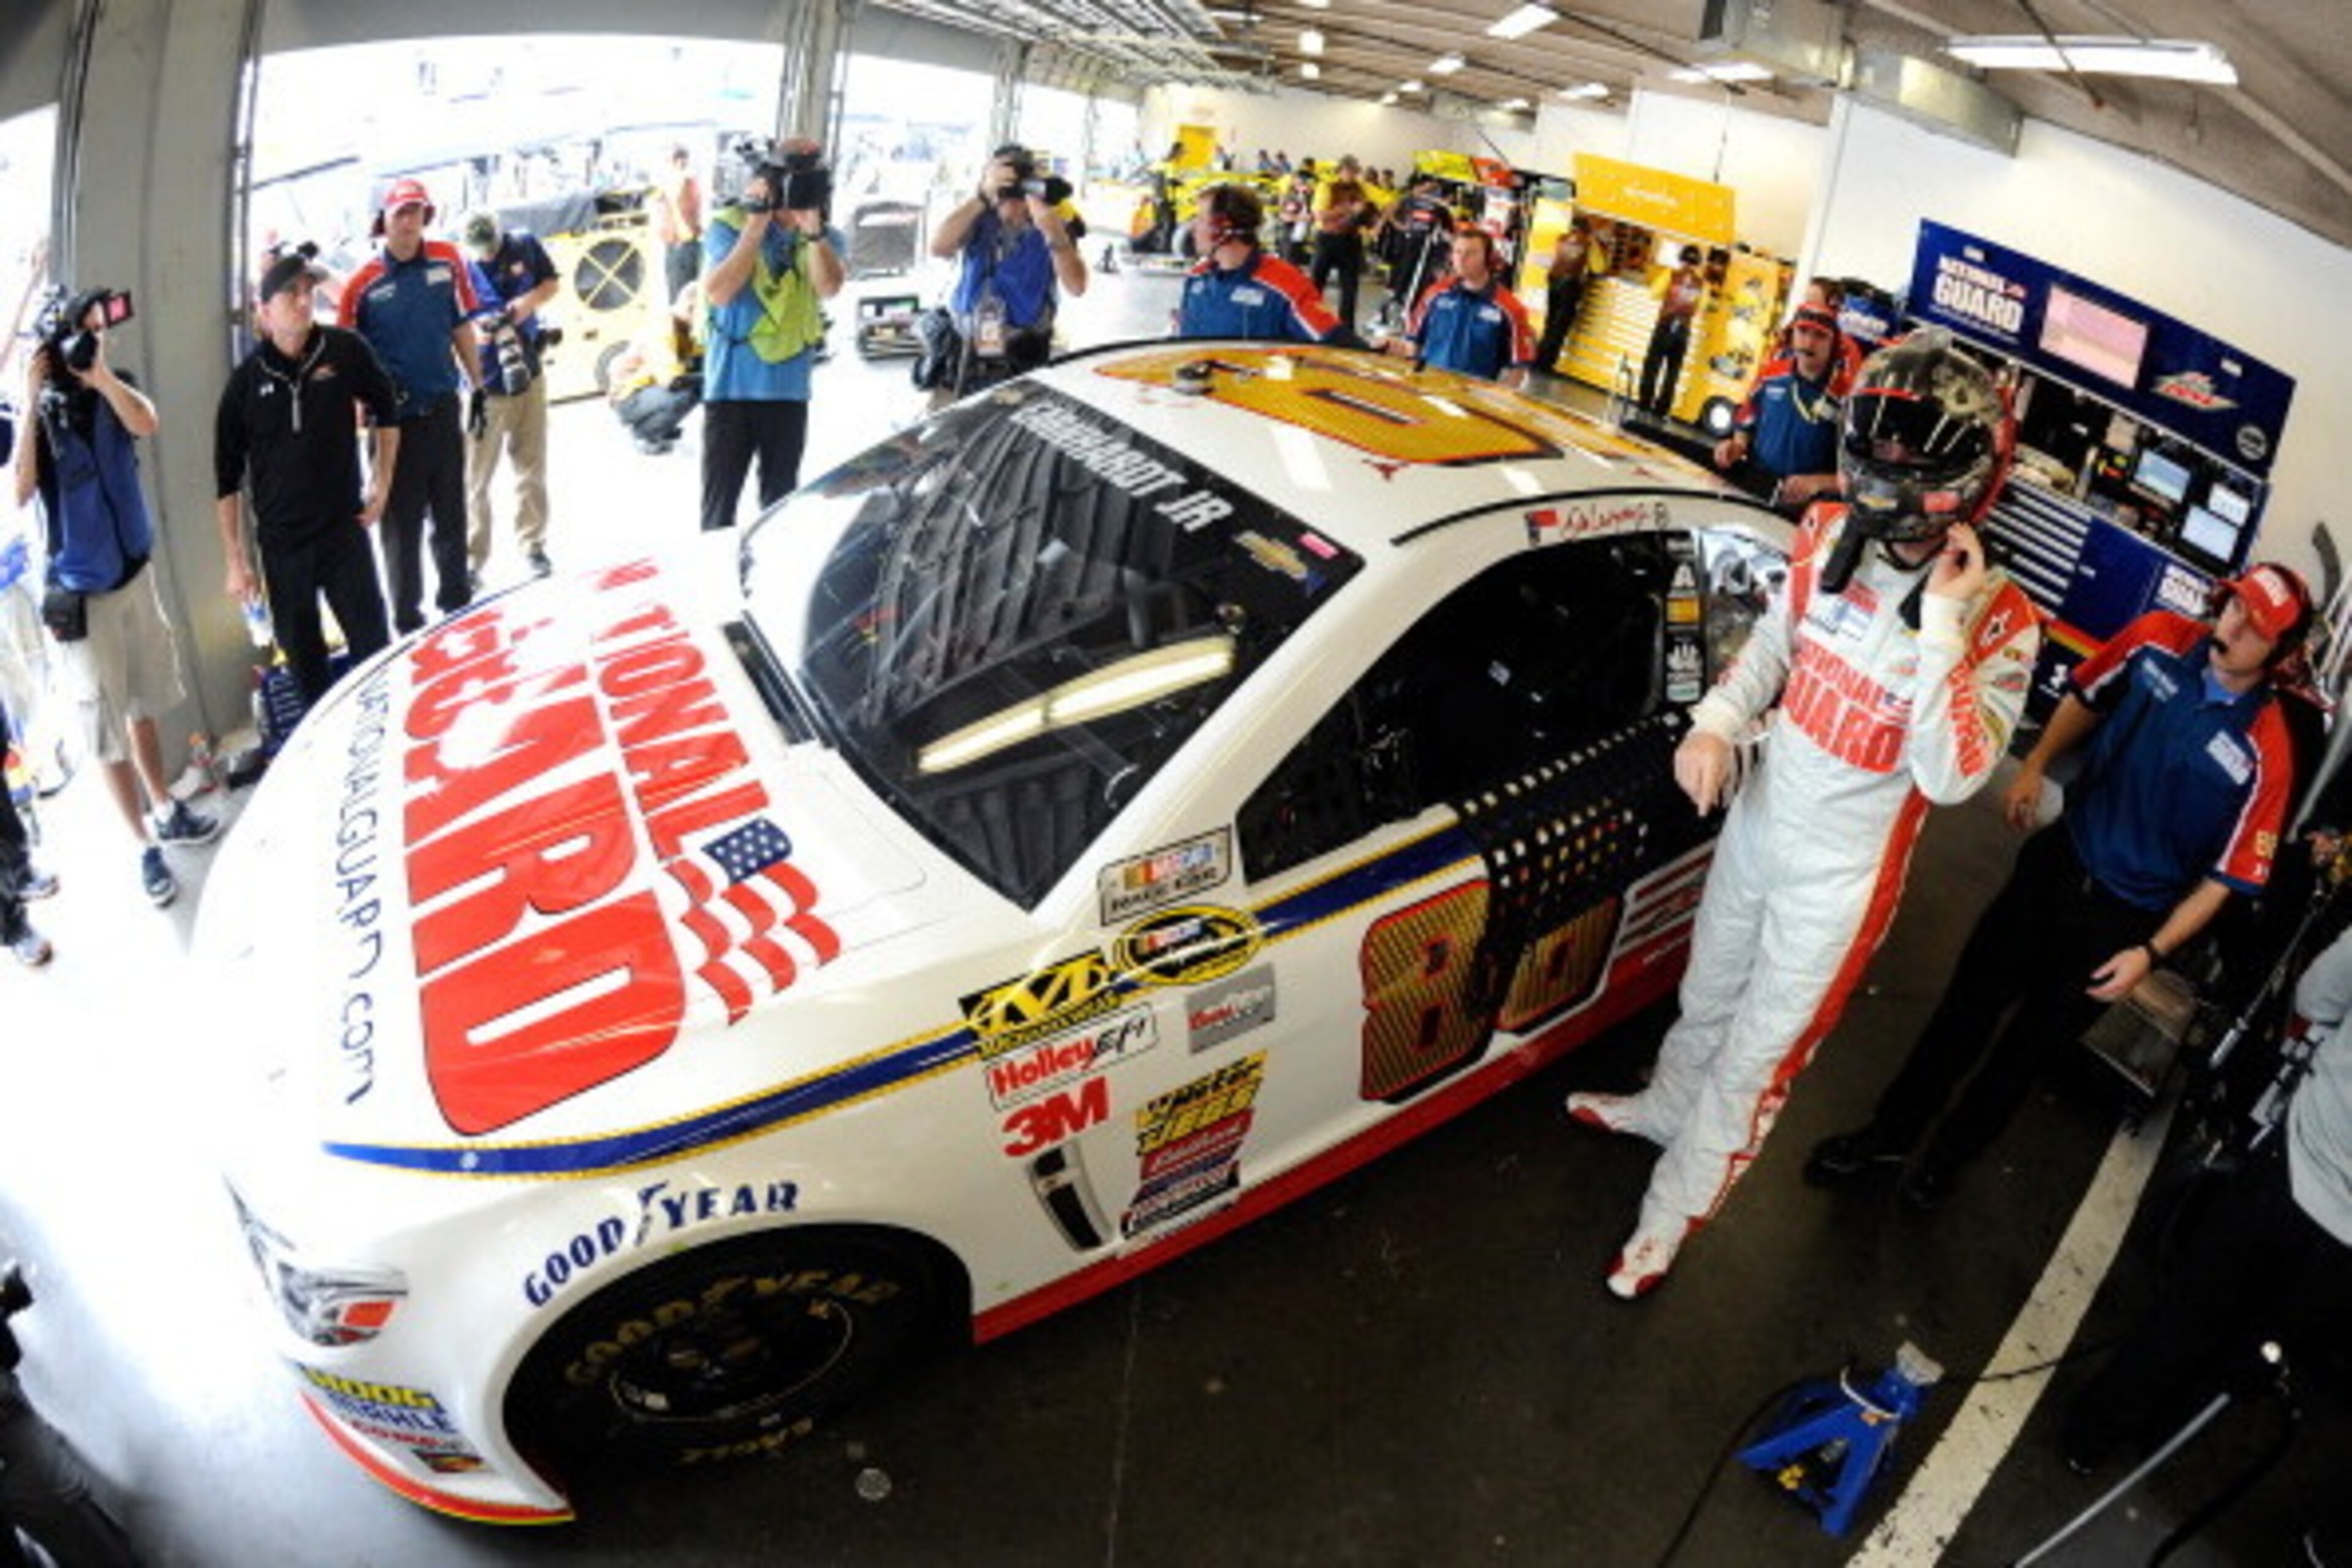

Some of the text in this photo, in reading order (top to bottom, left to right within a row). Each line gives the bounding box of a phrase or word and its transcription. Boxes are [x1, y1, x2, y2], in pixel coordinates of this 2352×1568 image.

[1933, 272, 2024, 334] GUARD
[990, 1036, 1095, 1096] Holley
[1002, 1076, 1110, 1159] 3M
